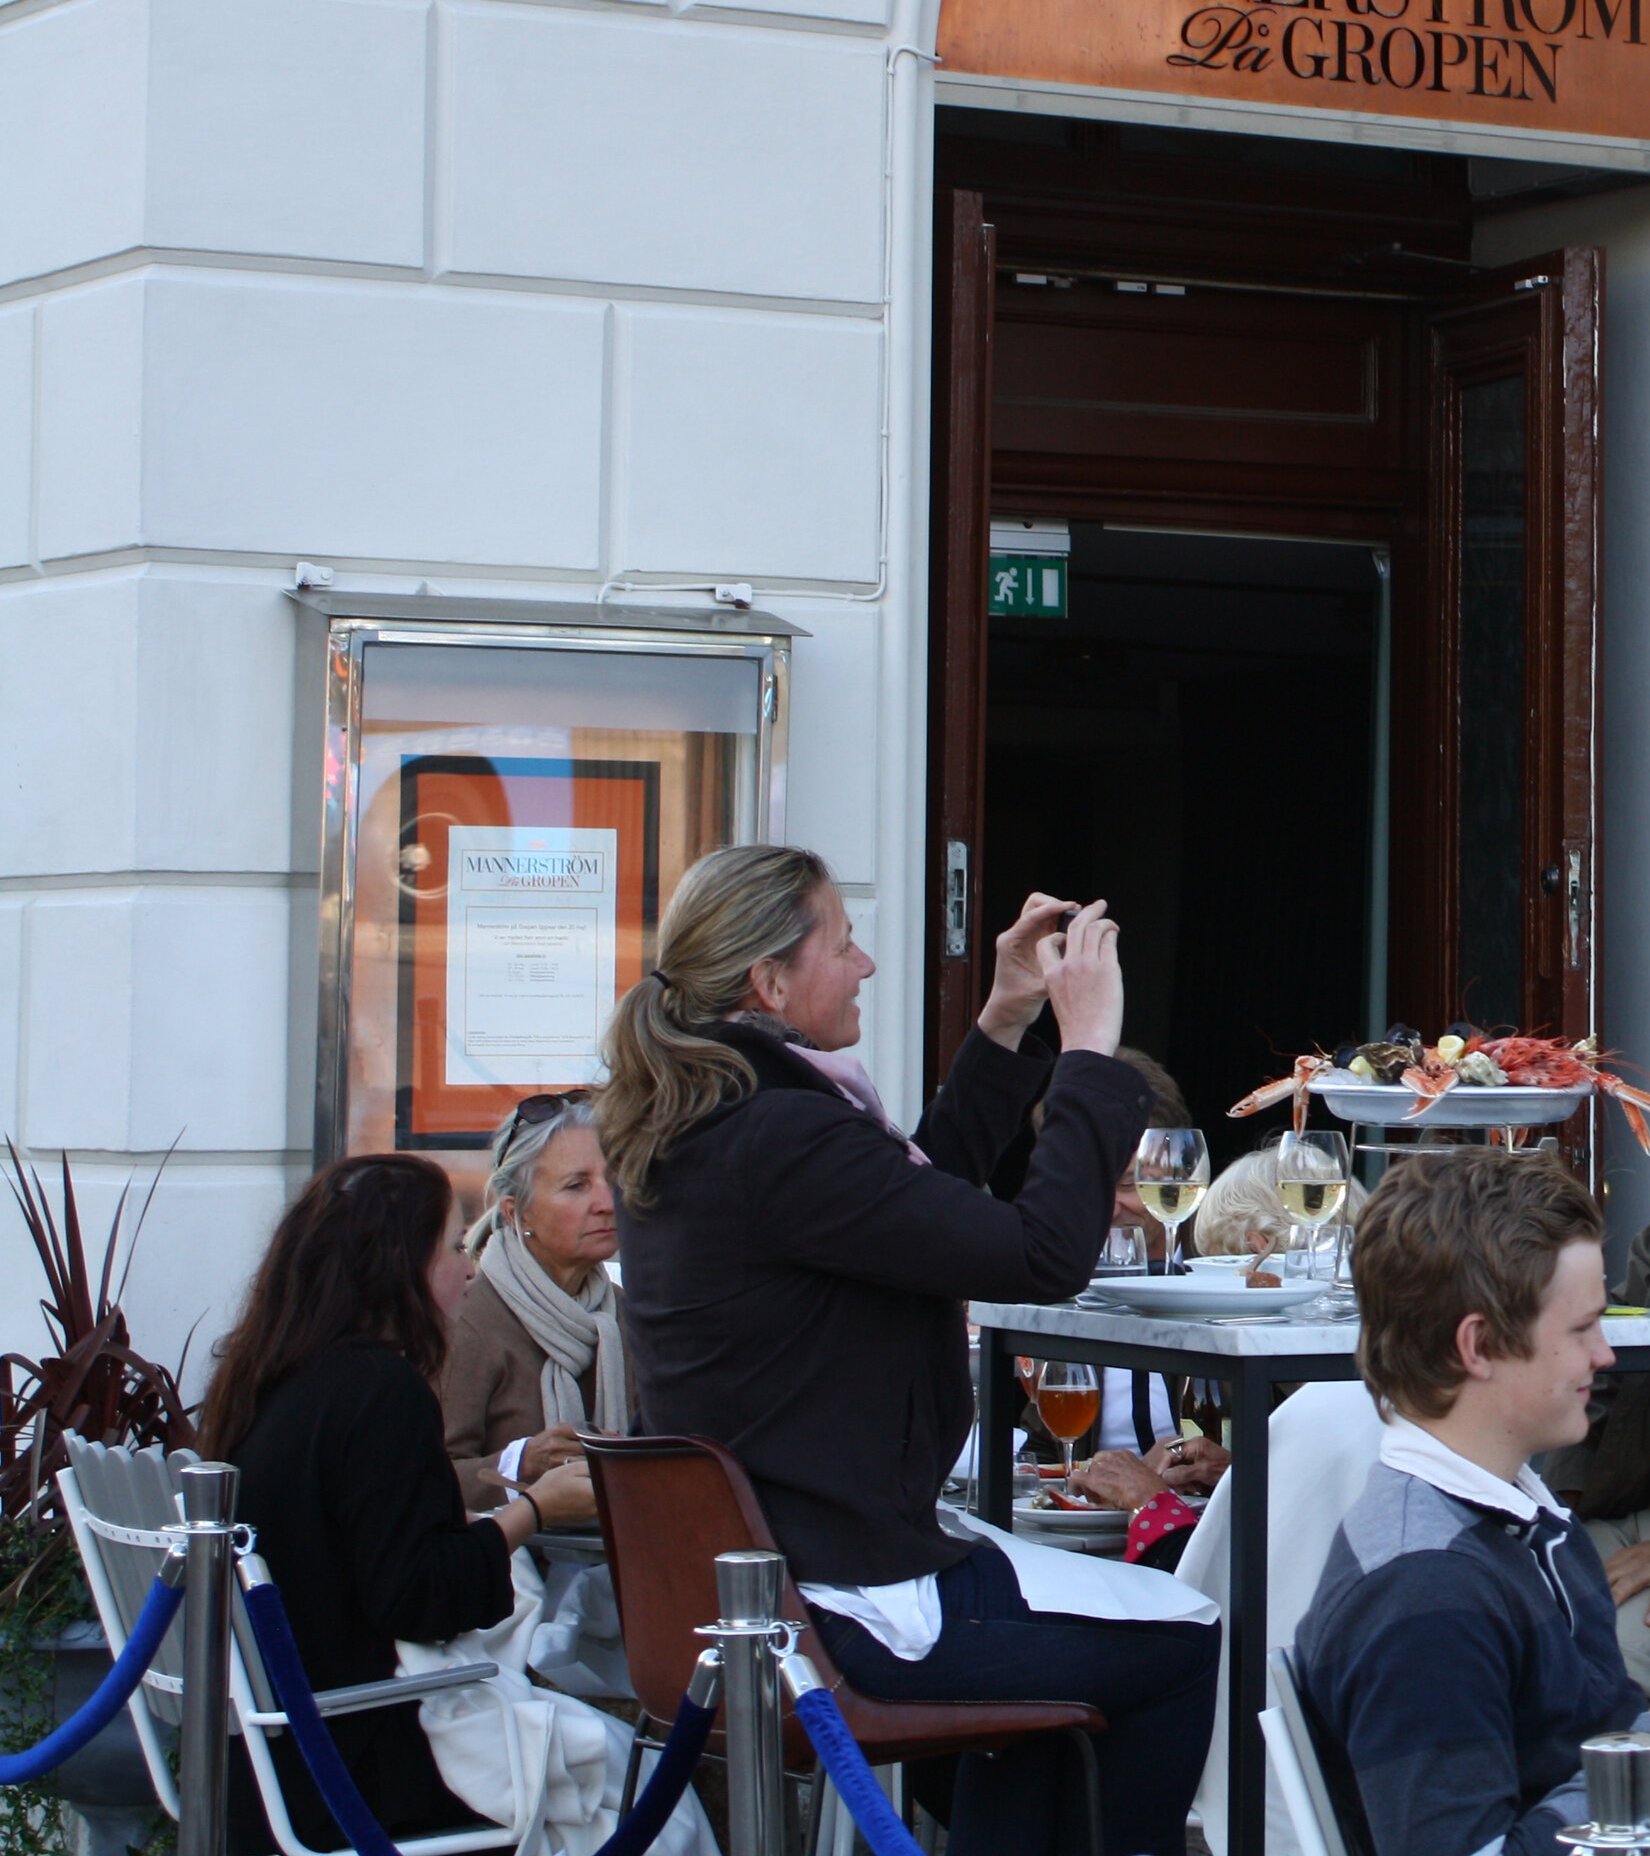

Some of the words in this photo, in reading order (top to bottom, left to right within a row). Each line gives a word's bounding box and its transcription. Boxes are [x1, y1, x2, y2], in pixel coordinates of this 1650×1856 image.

[1166, 7, 1277, 73] På
[1282, 16, 1563, 103] GROPEN
[466, 855, 598, 875] MANNERSTRÖM
[521, 875, 580, 888] GROPEN
